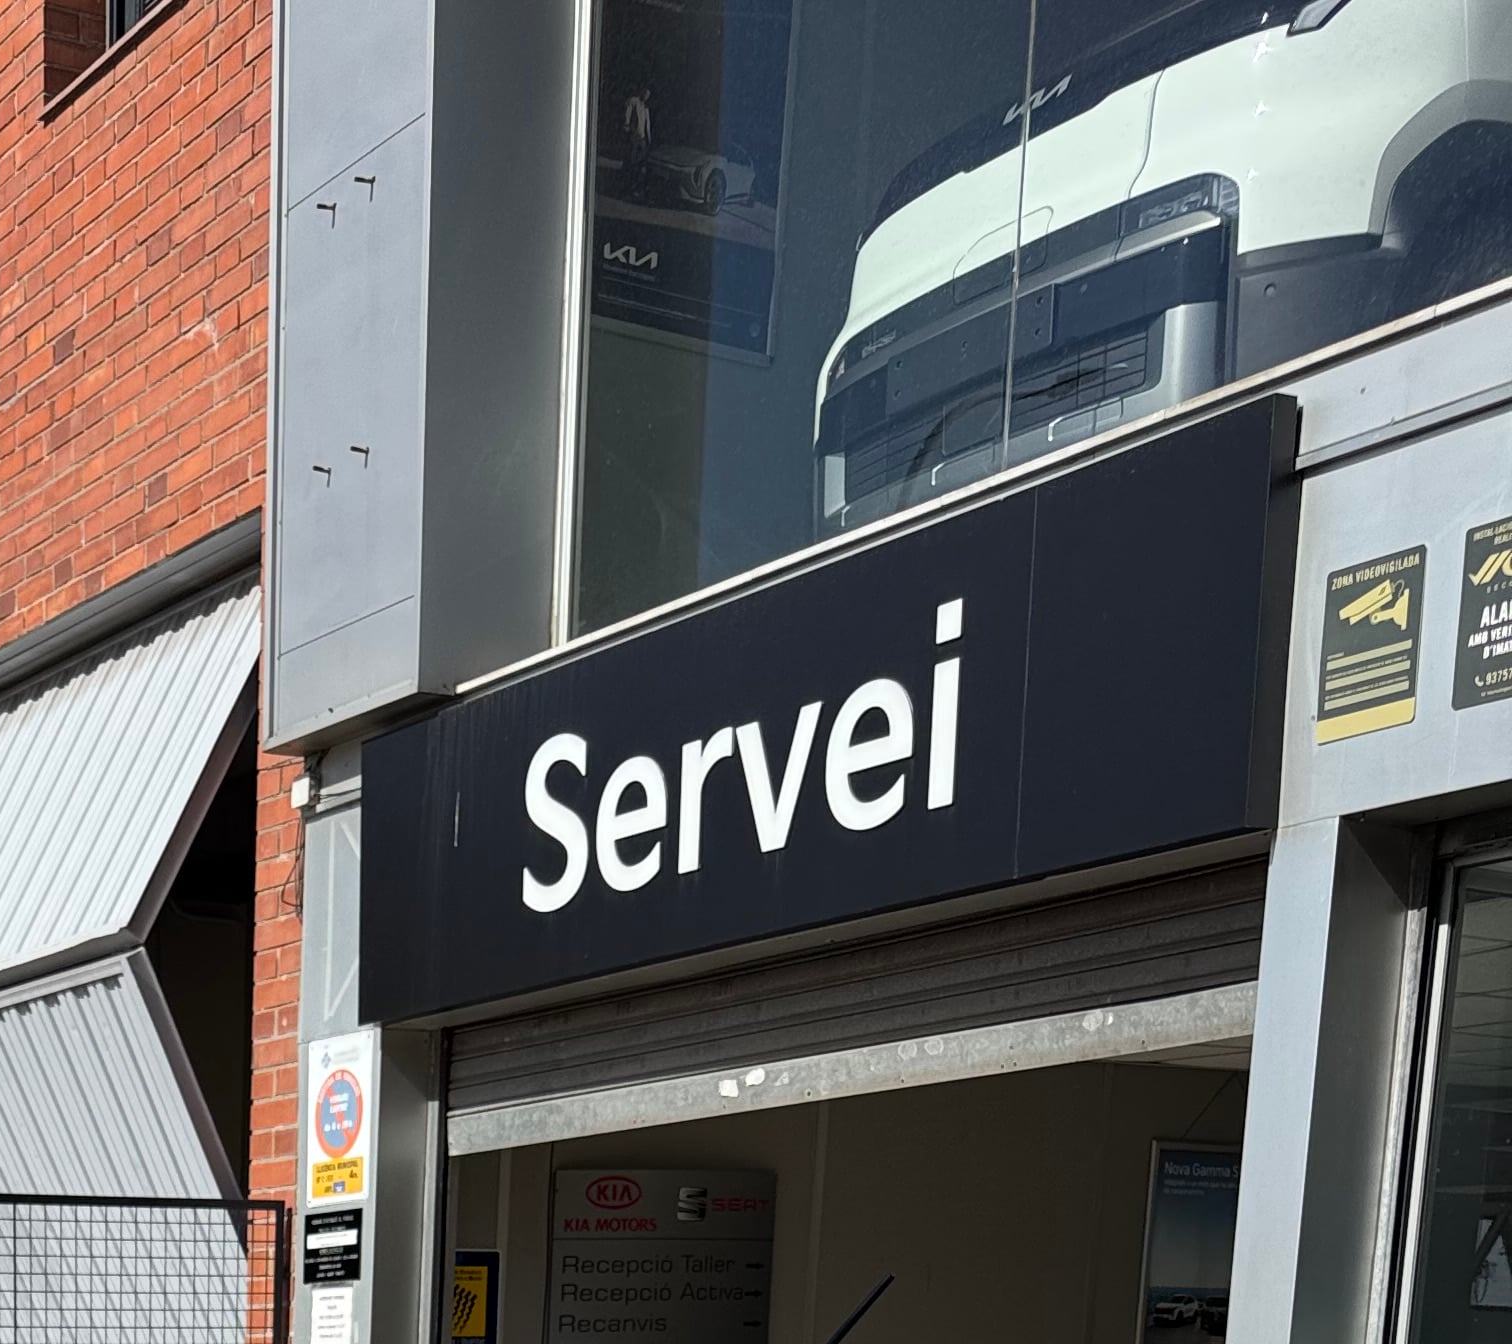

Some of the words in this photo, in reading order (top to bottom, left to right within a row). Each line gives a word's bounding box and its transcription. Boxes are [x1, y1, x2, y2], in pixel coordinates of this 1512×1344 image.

[603, 241, 659, 270] KIA
[1331, 573, 1354, 591] ZONA
[1355, 552, 1420, 584] VIDEOVIGILADA
[1467, 630, 1489, 648] AMB
[522, 597, 963, 913] Servei
[1164, 1161, 1190, 1175] Nova
[1191, 1163, 1231, 1177] Gamma
[596, 1184, 633, 1202] KIA
[711, 1198, 769, 1212] SEAT
[563, 1218, 590, 1232] KIA
[595, 1217, 657, 1232] MOTORS
[562, 1254, 673, 1278] Recepció
[681, 1254, 737, 1273] Taller
[560, 1282, 672, 1306] Recepció
[679, 1281, 744, 1301] Activa
[558, 1313, 668, 1333] Recanvis
